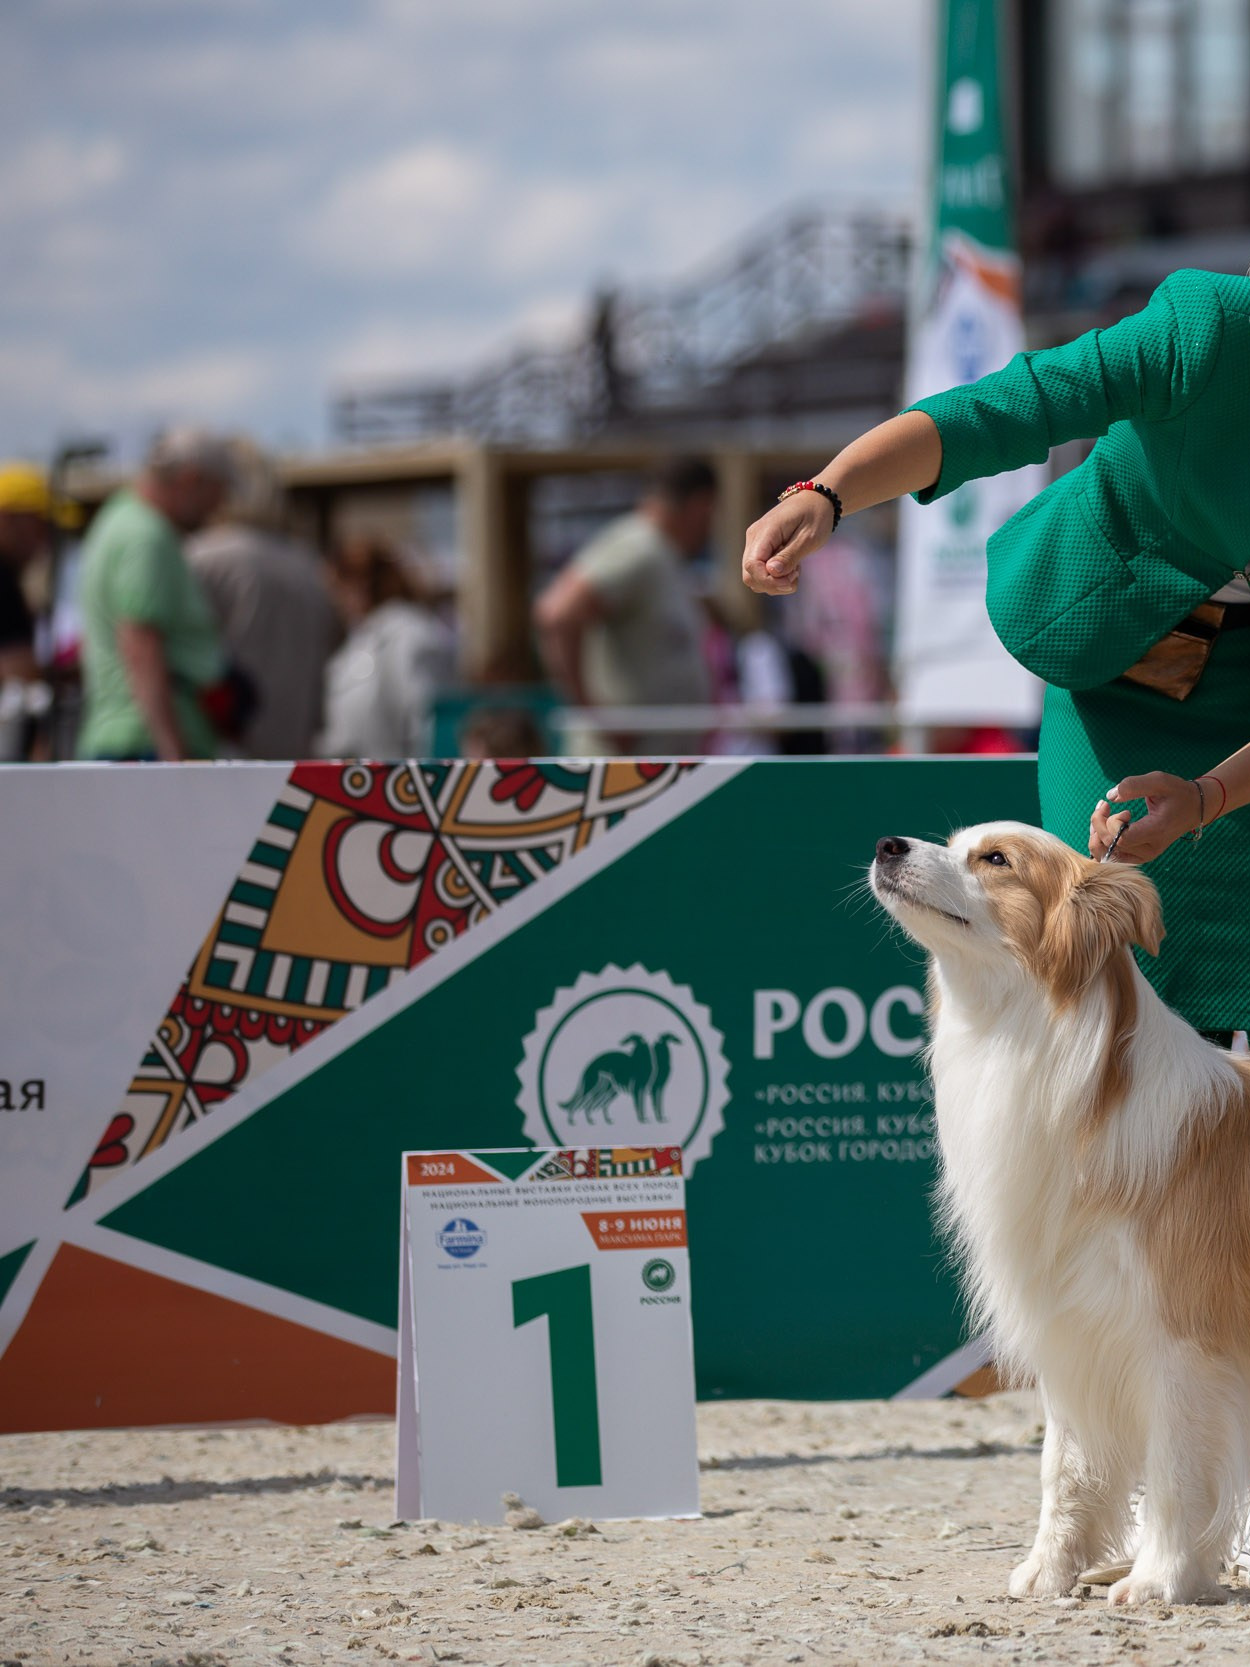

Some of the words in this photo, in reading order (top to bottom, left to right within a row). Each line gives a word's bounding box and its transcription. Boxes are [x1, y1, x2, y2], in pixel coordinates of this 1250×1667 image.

[754, 1141, 832, 1163] КУБОК
[421, 1162, 455, 1177] 2024
[422, 1187, 511, 1198] НАЦИОНАЛЬНЫЕ
[515, 1185, 571, 1194] ВЫСТАВКИ
[574, 1184, 609, 1192] СОБАК
[613, 1183, 639, 1191] ВСЕХ
[642, 1181, 679, 1190] ПОРОД
[430, 1199, 519, 1210] НАЦИОНАЛЬНЫЕ
[523, 1196, 612, 1206] МОНОПОРОДНЫЕ
[616, 1194, 672, 1203] ВЫСТАВКИ
[629, 1216, 682, 1231] ИЮНЯ
[511, 1263, 603, 1488] 1
